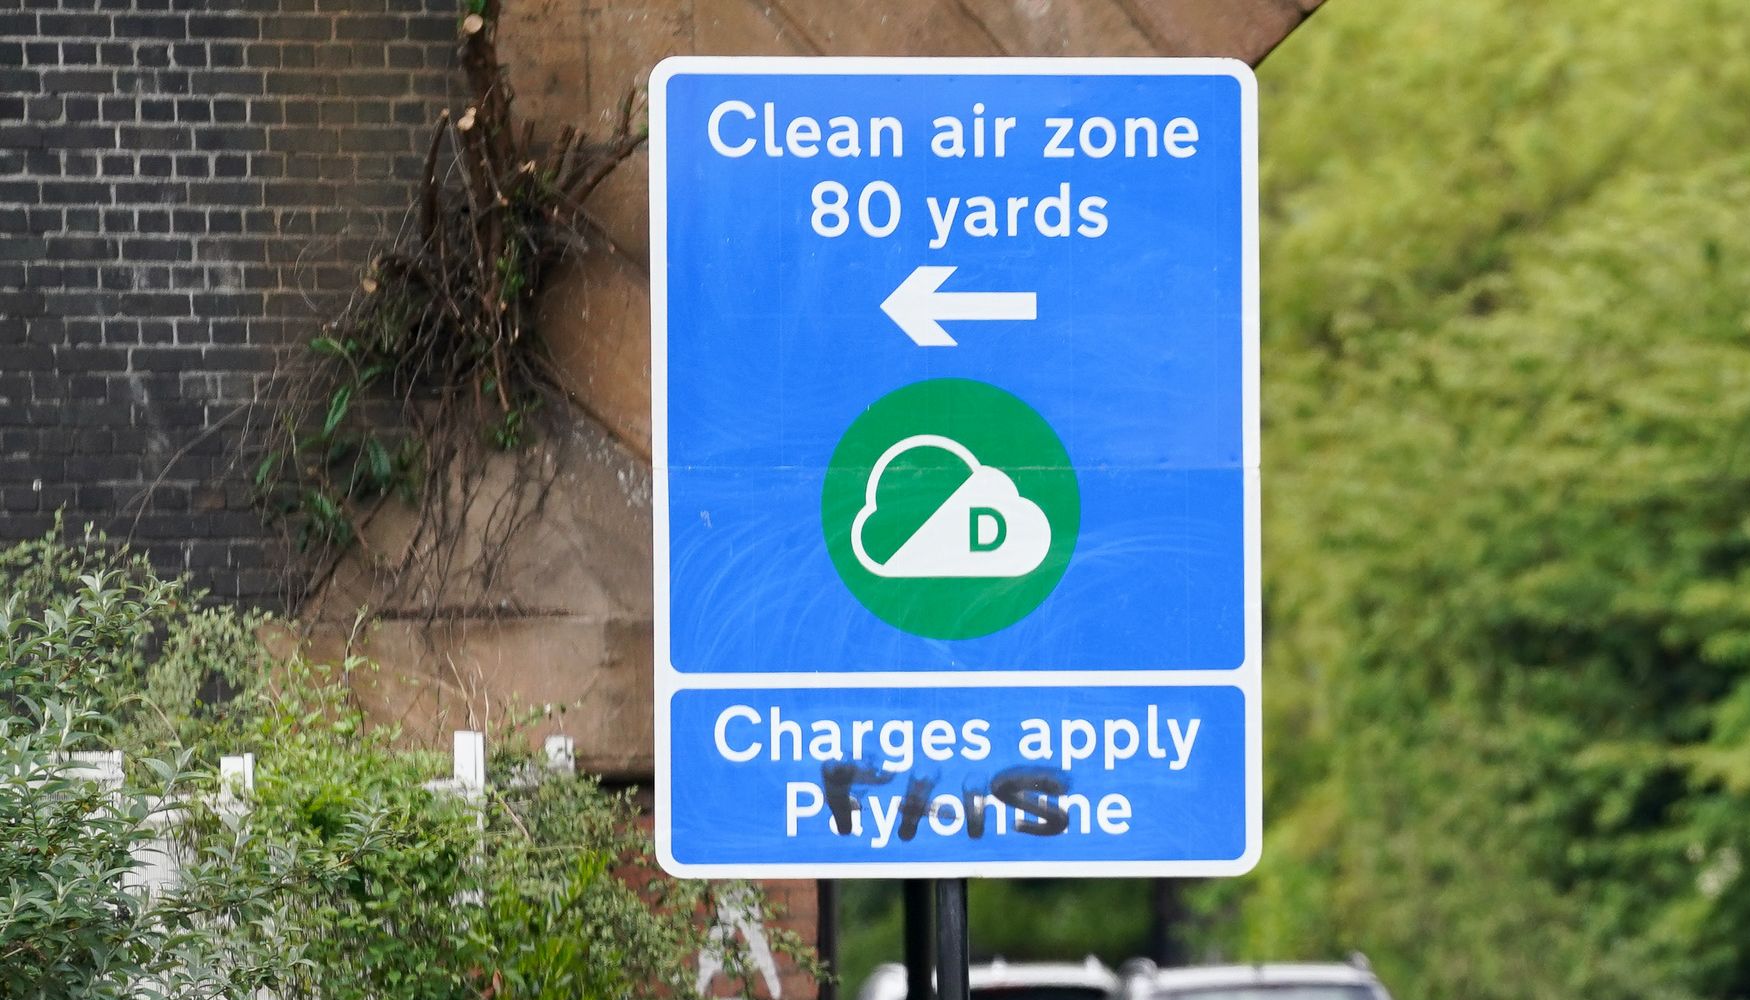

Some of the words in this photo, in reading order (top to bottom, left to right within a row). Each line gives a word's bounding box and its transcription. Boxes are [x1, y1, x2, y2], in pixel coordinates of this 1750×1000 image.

[707, 101, 903, 158] Clean
[930, 102, 1017, 158] air
[1043, 116, 1199, 159] zone
[811, 180, 901, 238] 80
[926, 182, 1109, 249] yards
[969, 506, 1007, 552] D
[714, 704, 991, 773] Charges
[1018, 704, 1201, 770] apply
